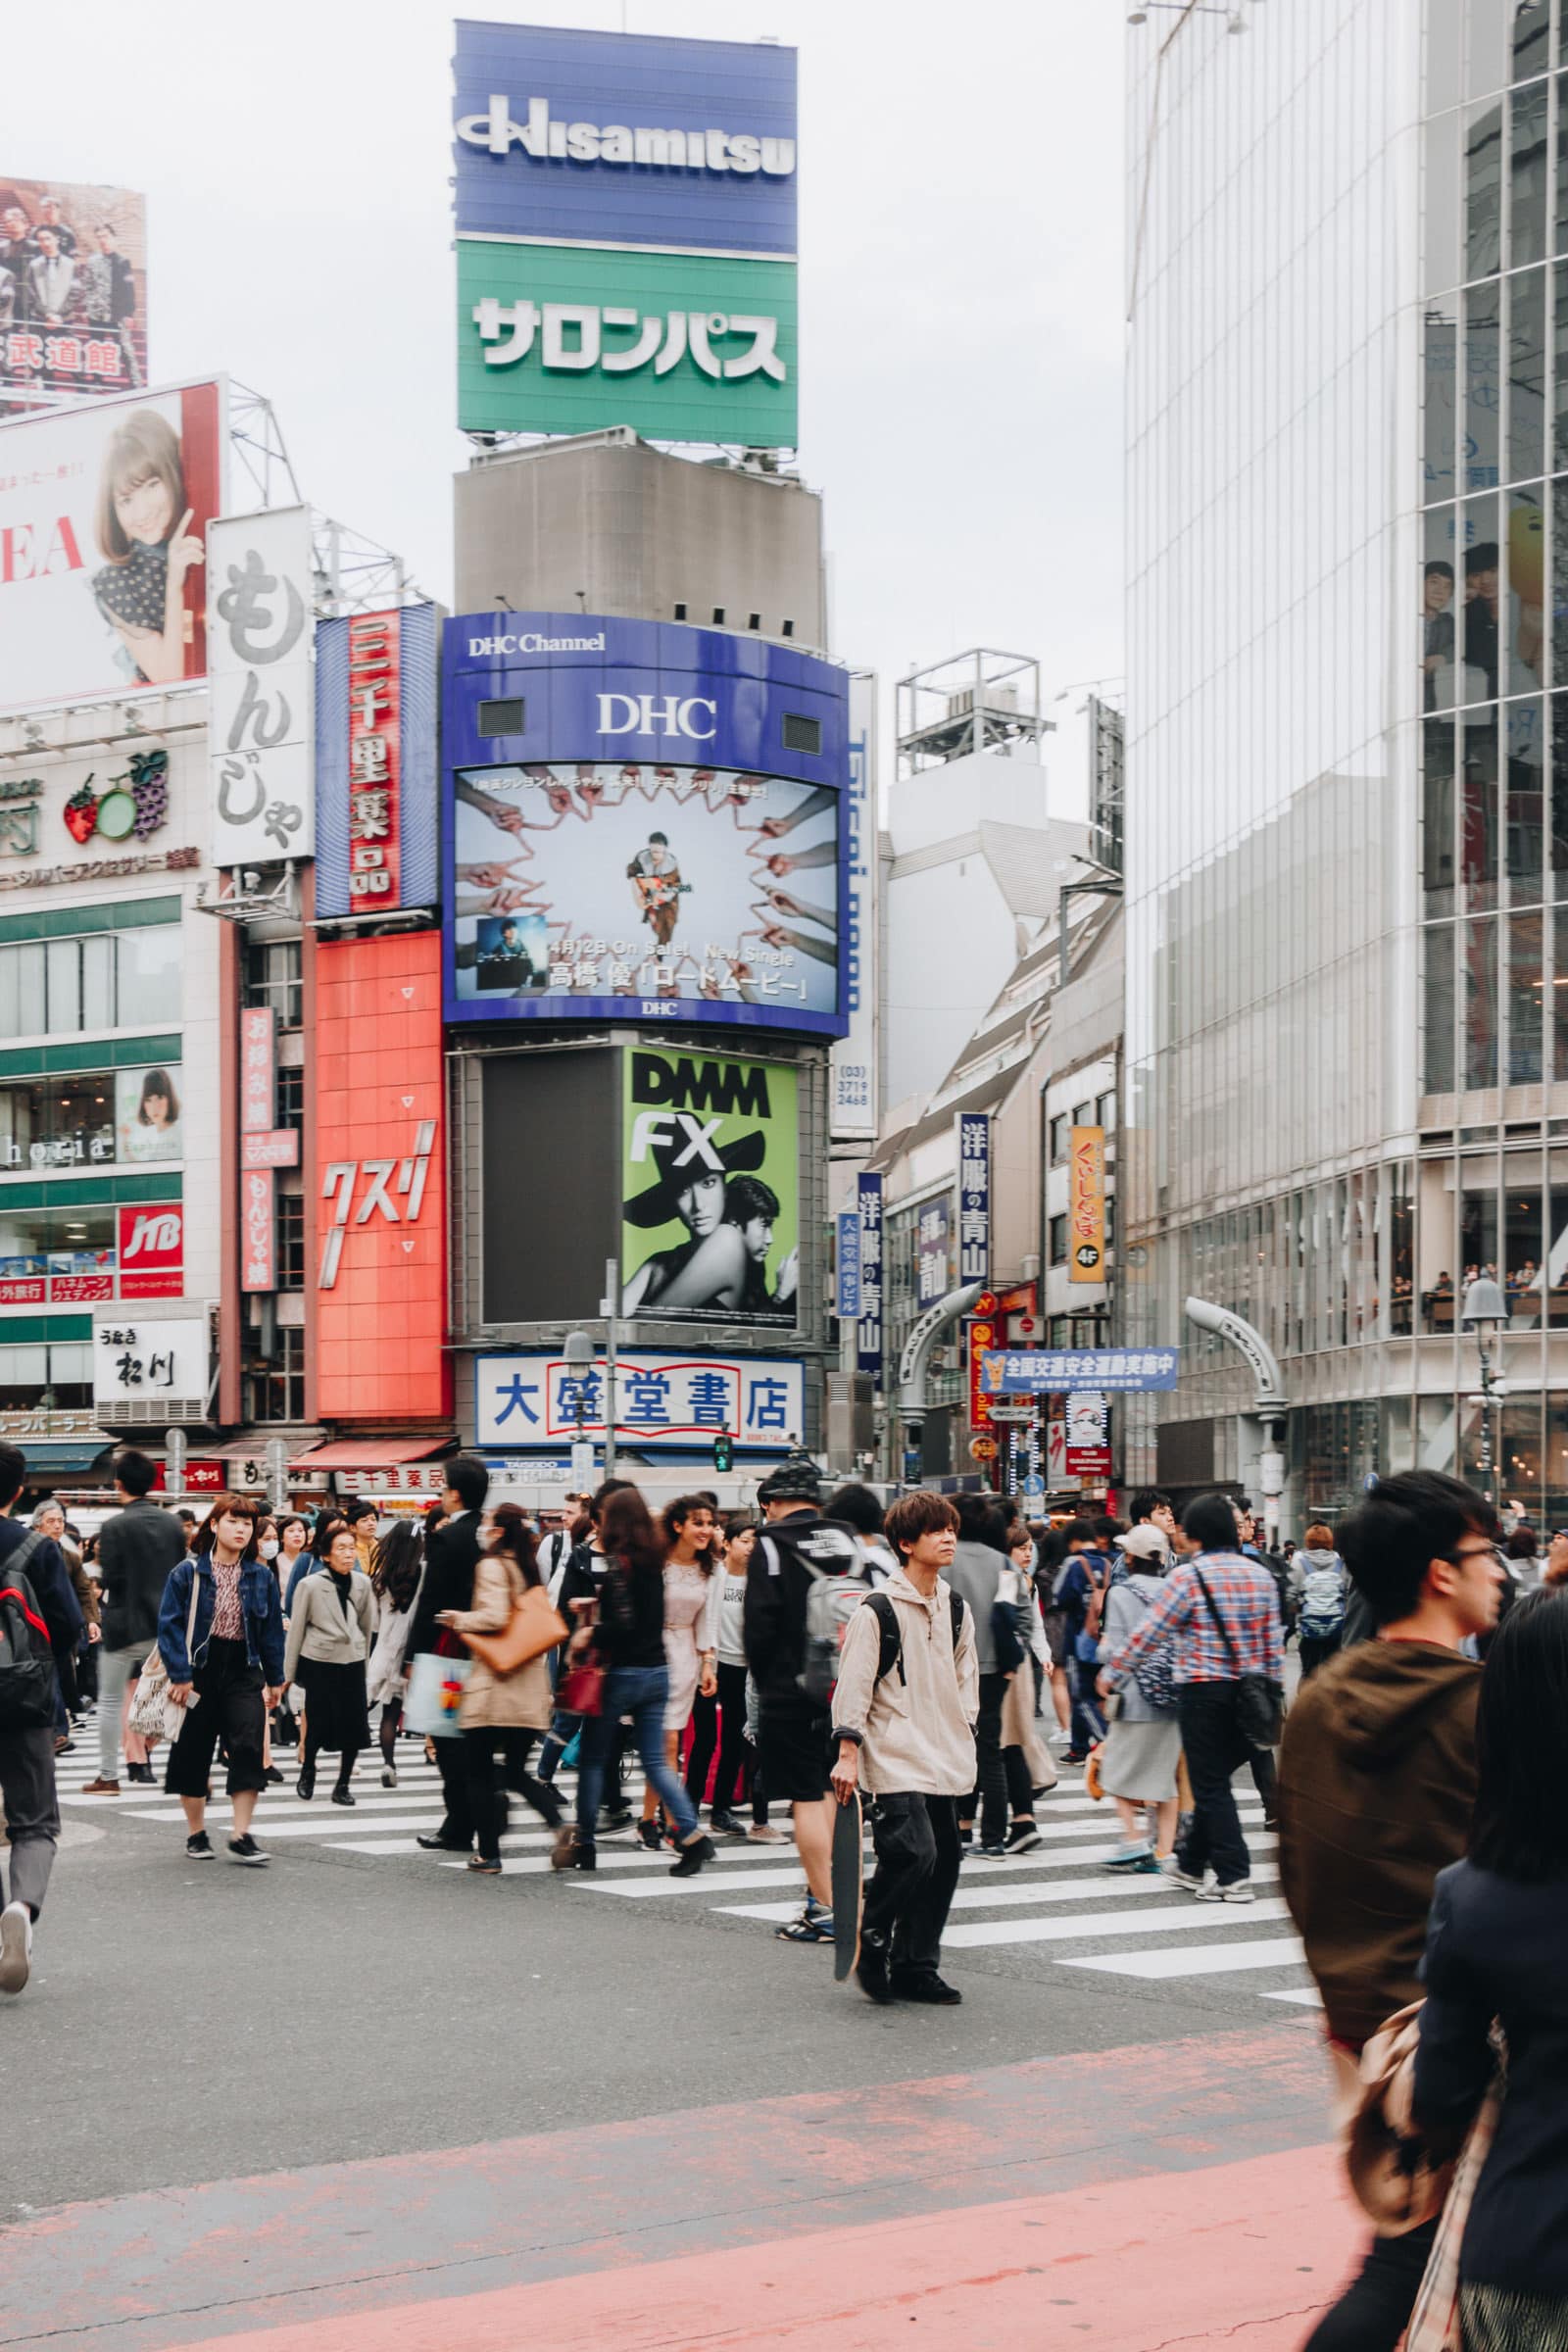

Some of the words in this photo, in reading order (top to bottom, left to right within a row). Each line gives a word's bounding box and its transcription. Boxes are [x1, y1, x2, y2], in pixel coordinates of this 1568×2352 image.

[457, 95, 795, 175] Hisamitsu
[0, 334, 122, 376] 武道館
[472, 298, 785, 382] サロンパス
[468, 635, 516, 658] DHC
[519, 633, 606, 654] Channel
[217, 549, 306, 849] もんじゃ
[596, 694, 717, 739] DHC
[350, 620, 391, 896] 三千里薬品
[612, 940, 639, 957] On
[644, 943, 690, 958] Sale!
[705, 944, 740, 962] New
[744, 946, 795, 968] Single
[642, 1001, 679, 1016] DHC
[631, 1052, 771, 1119] DMM
[838, 1081, 868, 1094] 3719
[840, 1064, 866, 1079] (03)
[837, 1094, 868, 1107] 2468
[630, 1112, 726, 1171] FX
[962, 1123, 988, 1277] 洋服の青山
[122, 1213, 181, 1259] JTB
[1077, 1249, 1099, 1265] 4F
[56, 1277, 108, 1290] ハネムーン
[1005, 1353, 1174, 1378] 全国交通安全運動実施中
[495, 1370, 790, 1430] 大盛堂書店
[344, 1469, 445, 1489] 三千里薬品
